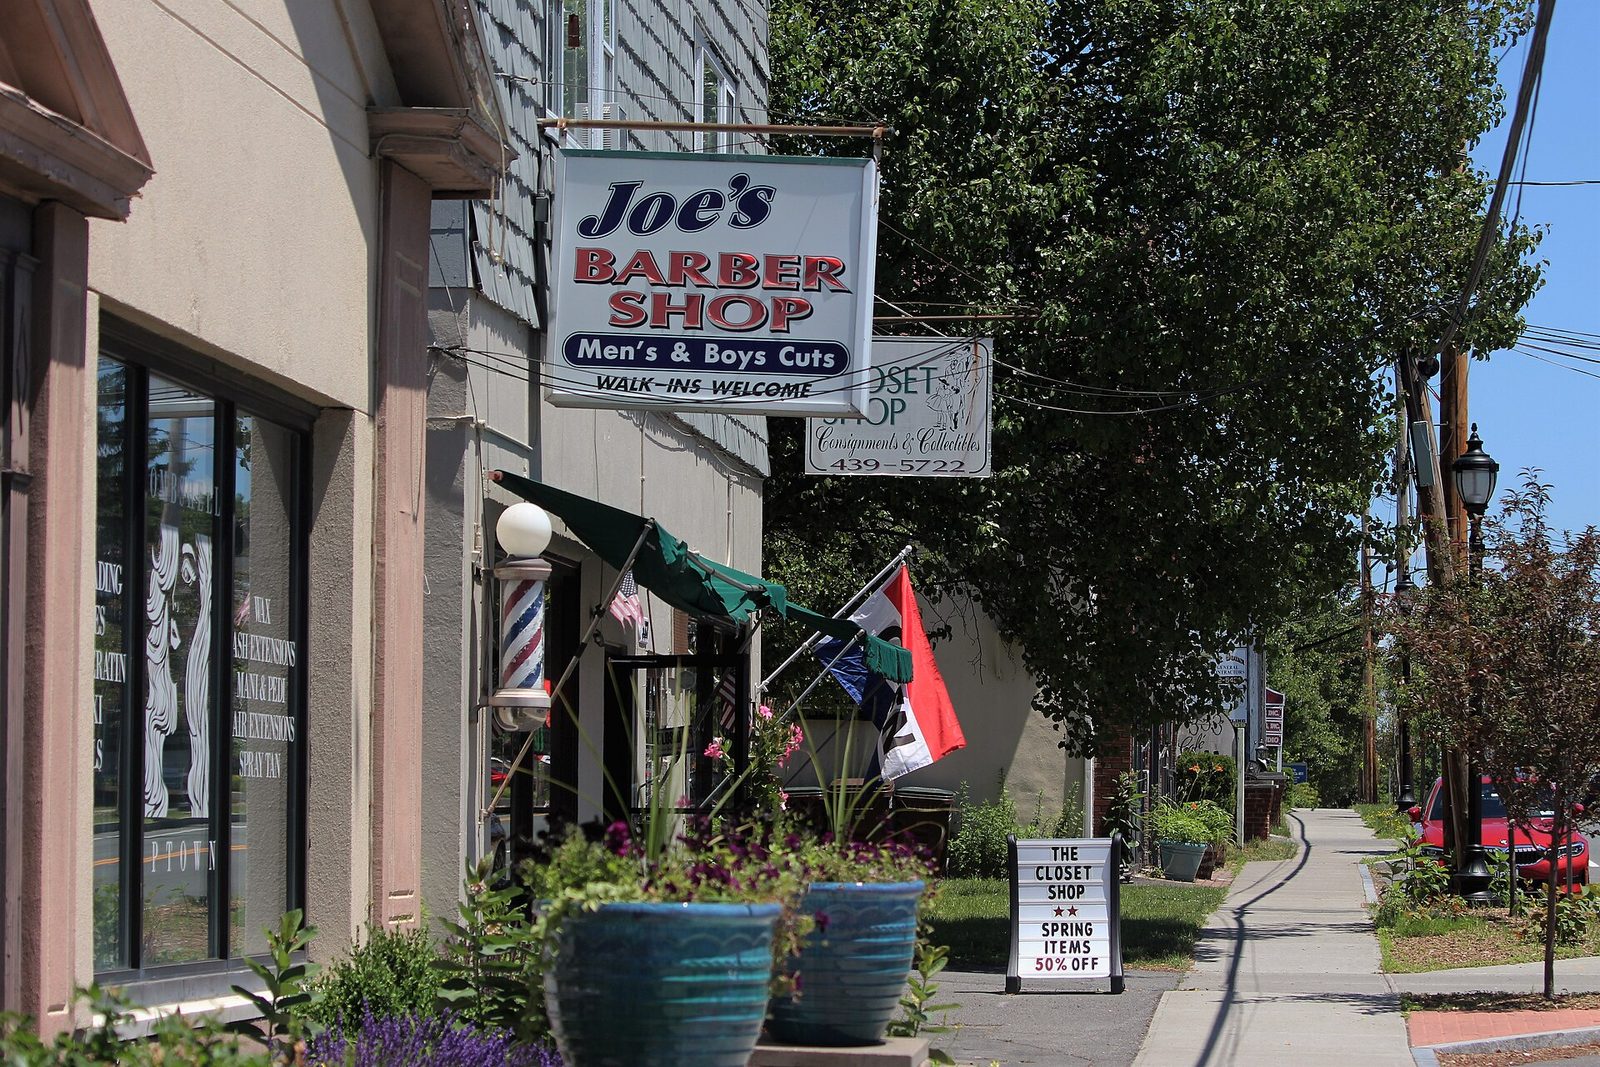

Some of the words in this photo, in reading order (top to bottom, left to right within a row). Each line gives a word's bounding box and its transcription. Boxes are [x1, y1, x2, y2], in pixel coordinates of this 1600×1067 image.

[575, 172, 777, 240] Joe's
[573, 247, 853, 294] BARBER
[608, 290, 814, 334] SHOP
[577, 339, 658, 363] Men's
[671, 342, 691, 363] &
[705, 344, 767, 371] Boys
[779, 346, 835, 368] Cuts
[596, 375, 702, 395] WALK-INS
[711, 380, 812, 399] WELCOME
[816, 426, 899, 458] Consignments
[902, 432, 915, 455] &
[917, 427, 980, 455] Collectibles
[830, 458, 966, 473] 439-5722
[95, 560, 123, 595] DING
[253, 595, 272, 625] WAX
[232, 631, 249, 660] ASH
[249, 634, 296, 668] EXTENSIONS
[94, 650, 127, 683] RATIN
[236, 671, 259, 700] MANI
[260, 674, 267, 702] &
[268, 675, 286, 704] PEDI
[232, 710, 248, 738] AIR
[249, 712, 295, 743] EXTENSIONS
[239, 750, 265, 778] SPRAY
[265, 752, 282, 779] TAN
[1051, 846, 1079, 862] THE
[1035, 865, 1092, 881] CLOSET
[1047, 884, 1085, 900] SHOP
[1041, 922, 1093, 937] SPRING
[1044, 940, 1091, 954] ITEMS
[1035, 957, 1068, 971] 50%
[1071, 957, 1099, 971] OFF
